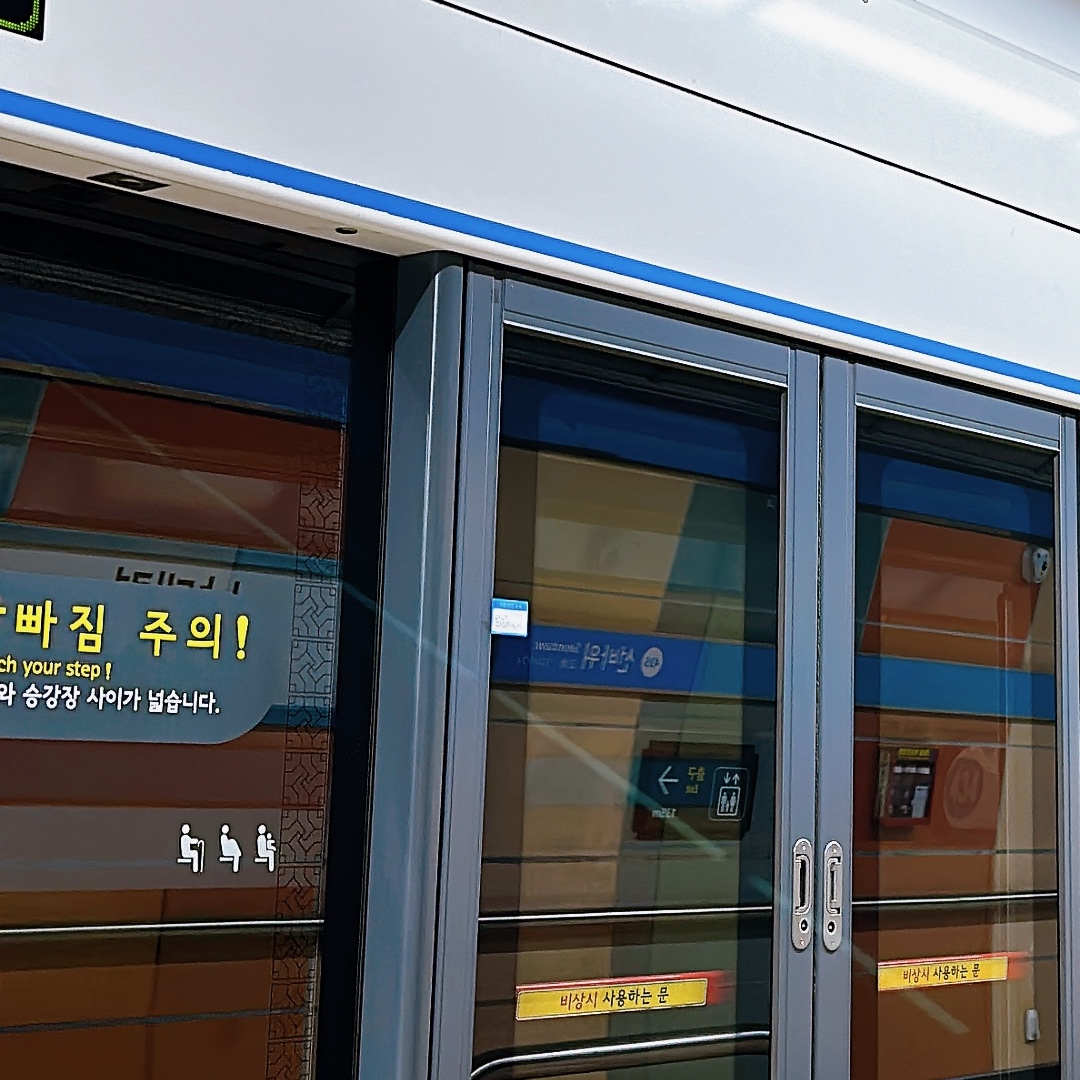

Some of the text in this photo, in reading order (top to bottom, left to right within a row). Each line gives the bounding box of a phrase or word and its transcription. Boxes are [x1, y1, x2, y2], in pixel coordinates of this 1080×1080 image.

[0, 599, 249, 661] 빠짐 주의!
[22, 660, 61, 678] your
[22, 683, 81, 710] 승강장
[86, 686, 142, 712] 사이가
[148, 689, 220, 715] 넓습니다.
[902, 963, 981, 984] 비상시 사용하는 문
[560, 986, 670, 1011] 비상시 사용하는 문
